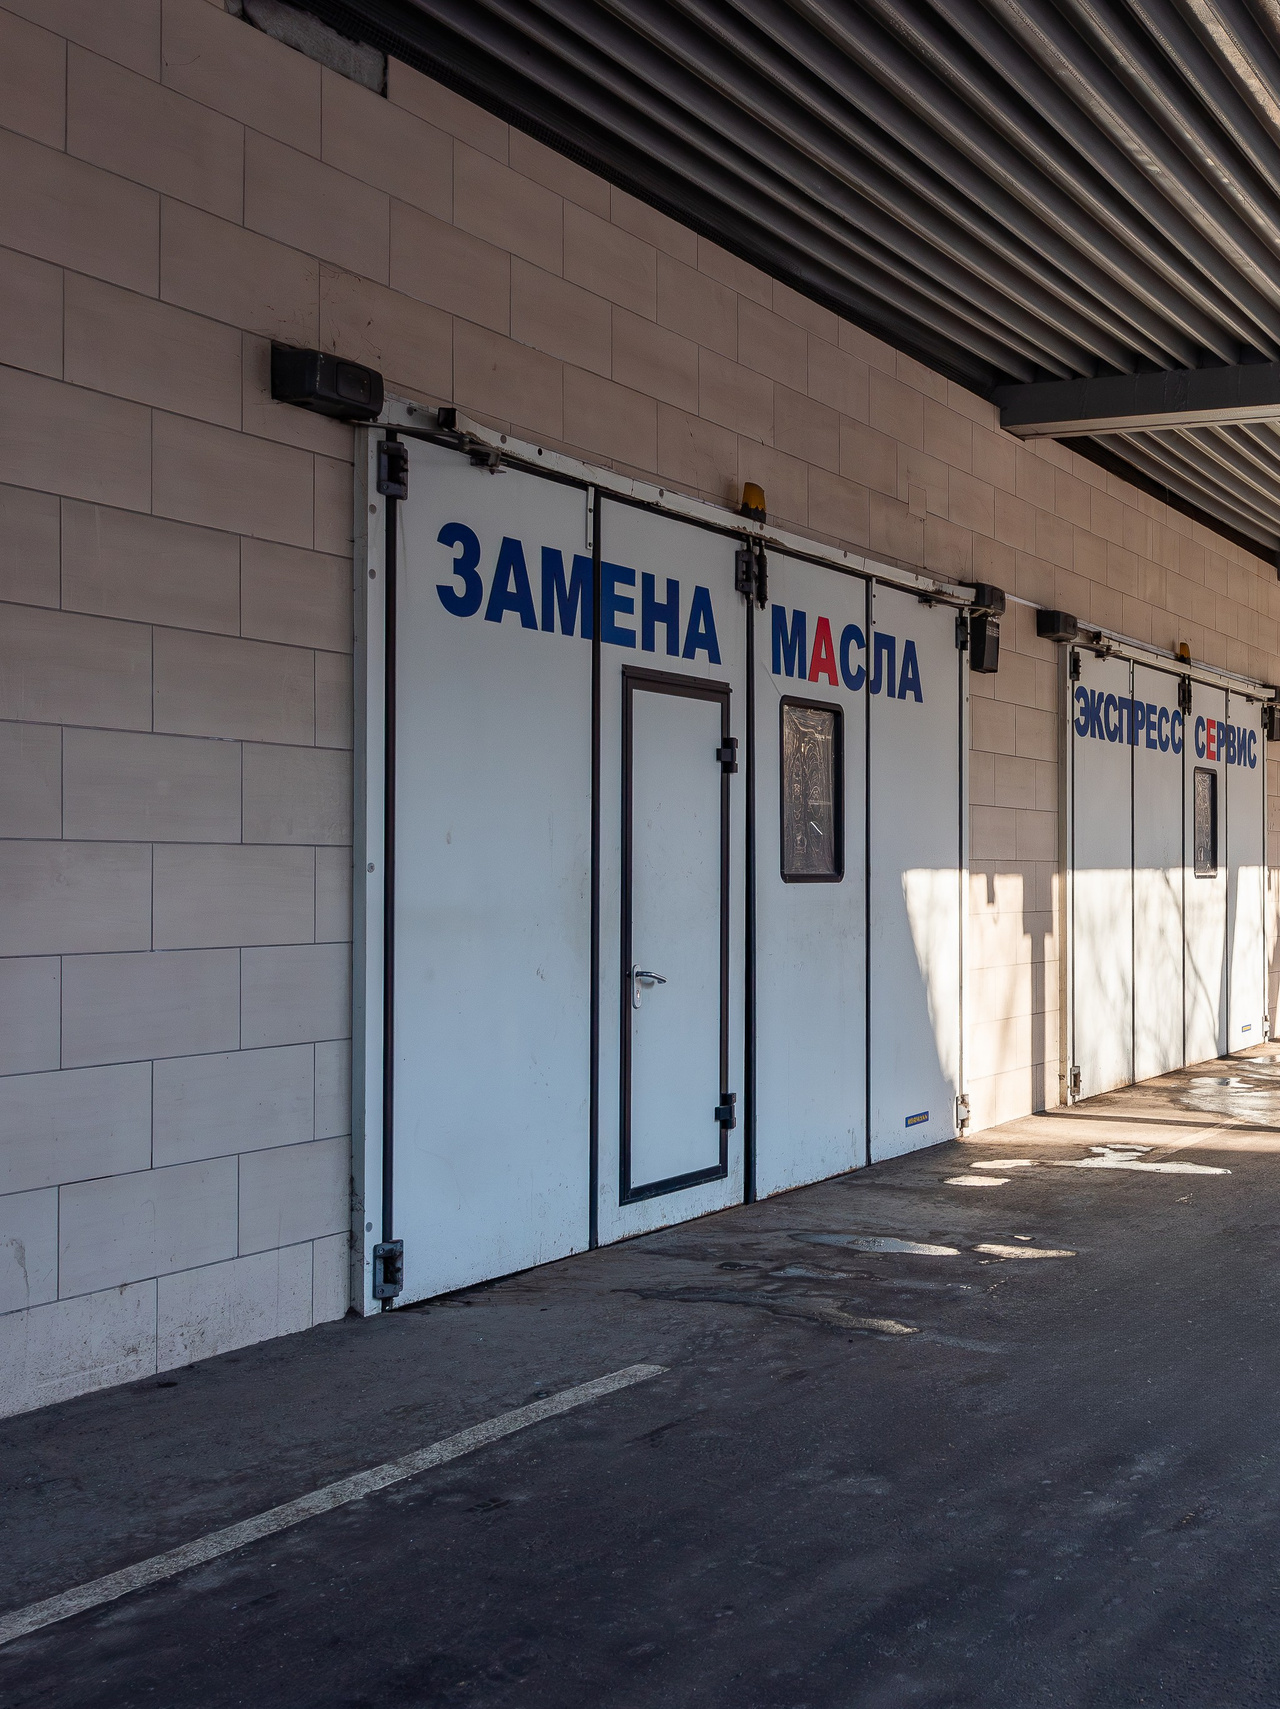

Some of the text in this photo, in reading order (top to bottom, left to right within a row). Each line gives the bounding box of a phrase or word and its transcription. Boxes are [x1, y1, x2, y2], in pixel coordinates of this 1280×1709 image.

[436, 521, 923, 704] ЗАМЕНА МАСЛА
[1074, 685, 1257, 770] ЭКСПРЕСС СЕРВИС
